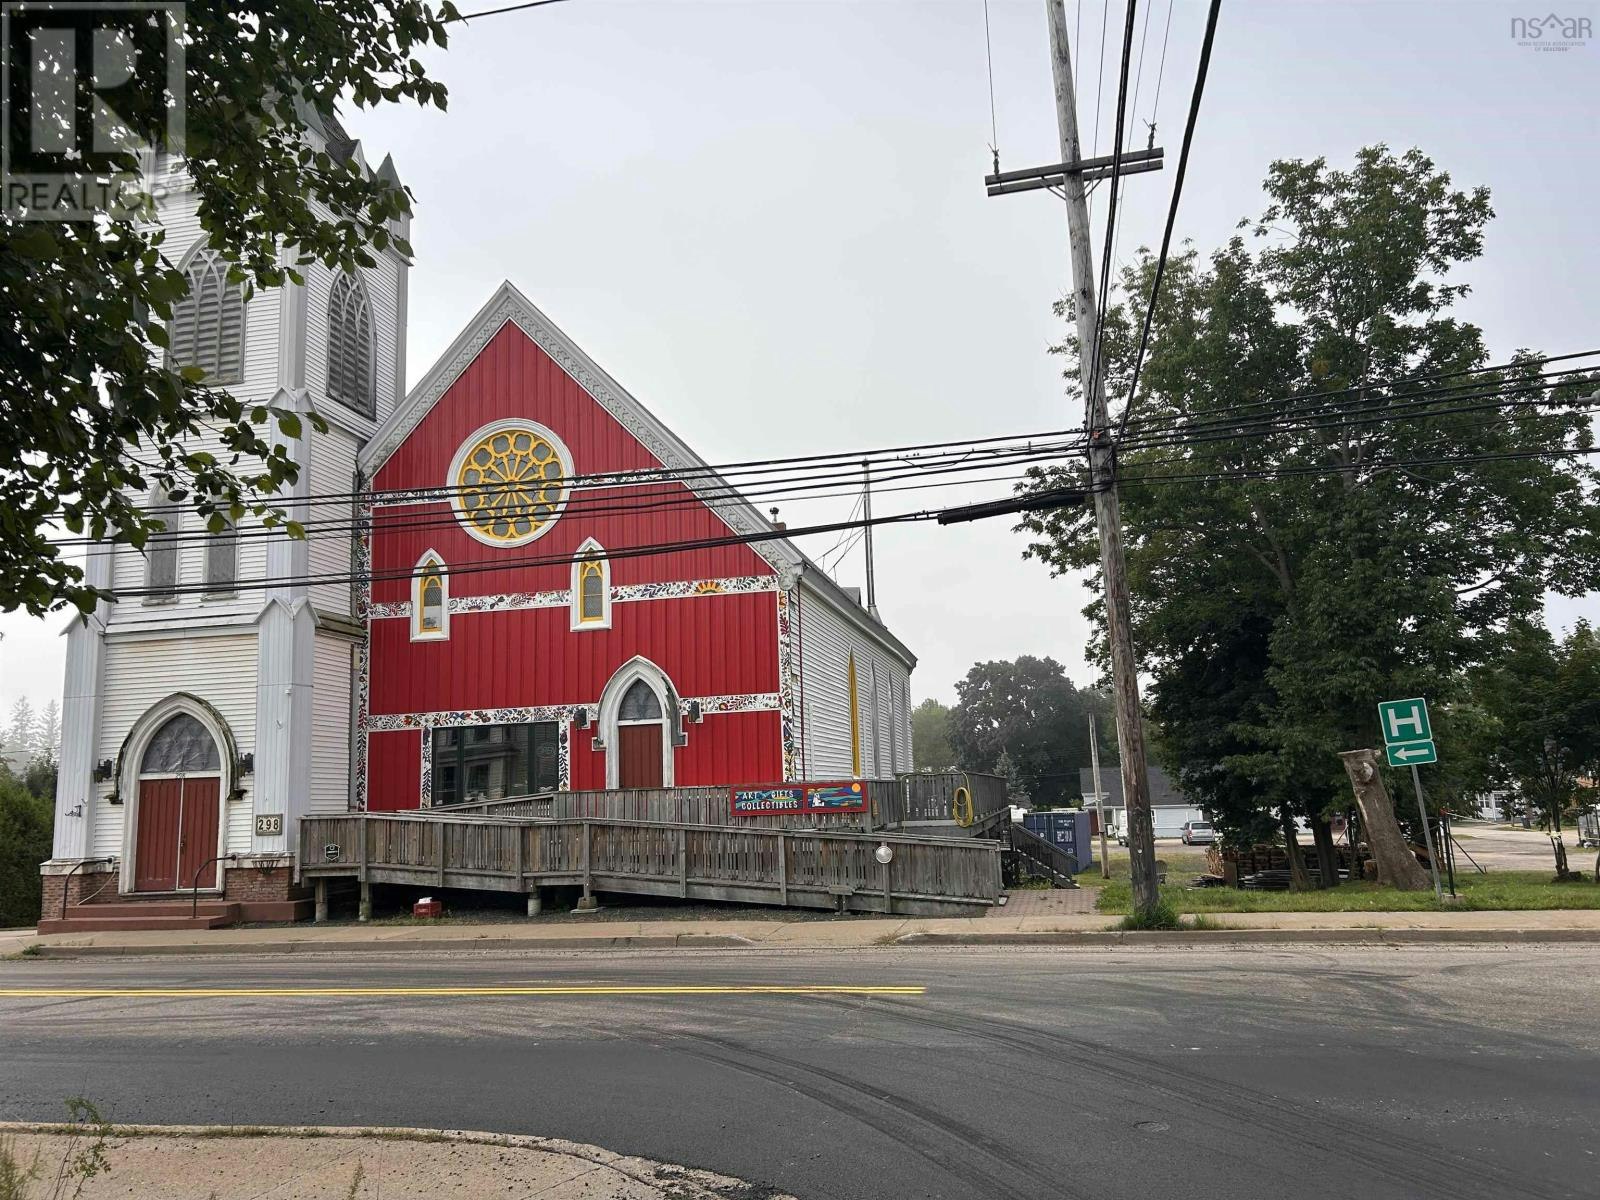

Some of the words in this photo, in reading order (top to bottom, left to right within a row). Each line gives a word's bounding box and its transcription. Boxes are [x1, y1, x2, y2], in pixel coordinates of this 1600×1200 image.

[1387, 706, 1423, 737] H
[771, 790, 794, 798] GIFTS
[741, 800, 798, 810] COLLECTIBLES
[258, 819, 279, 830] 298
